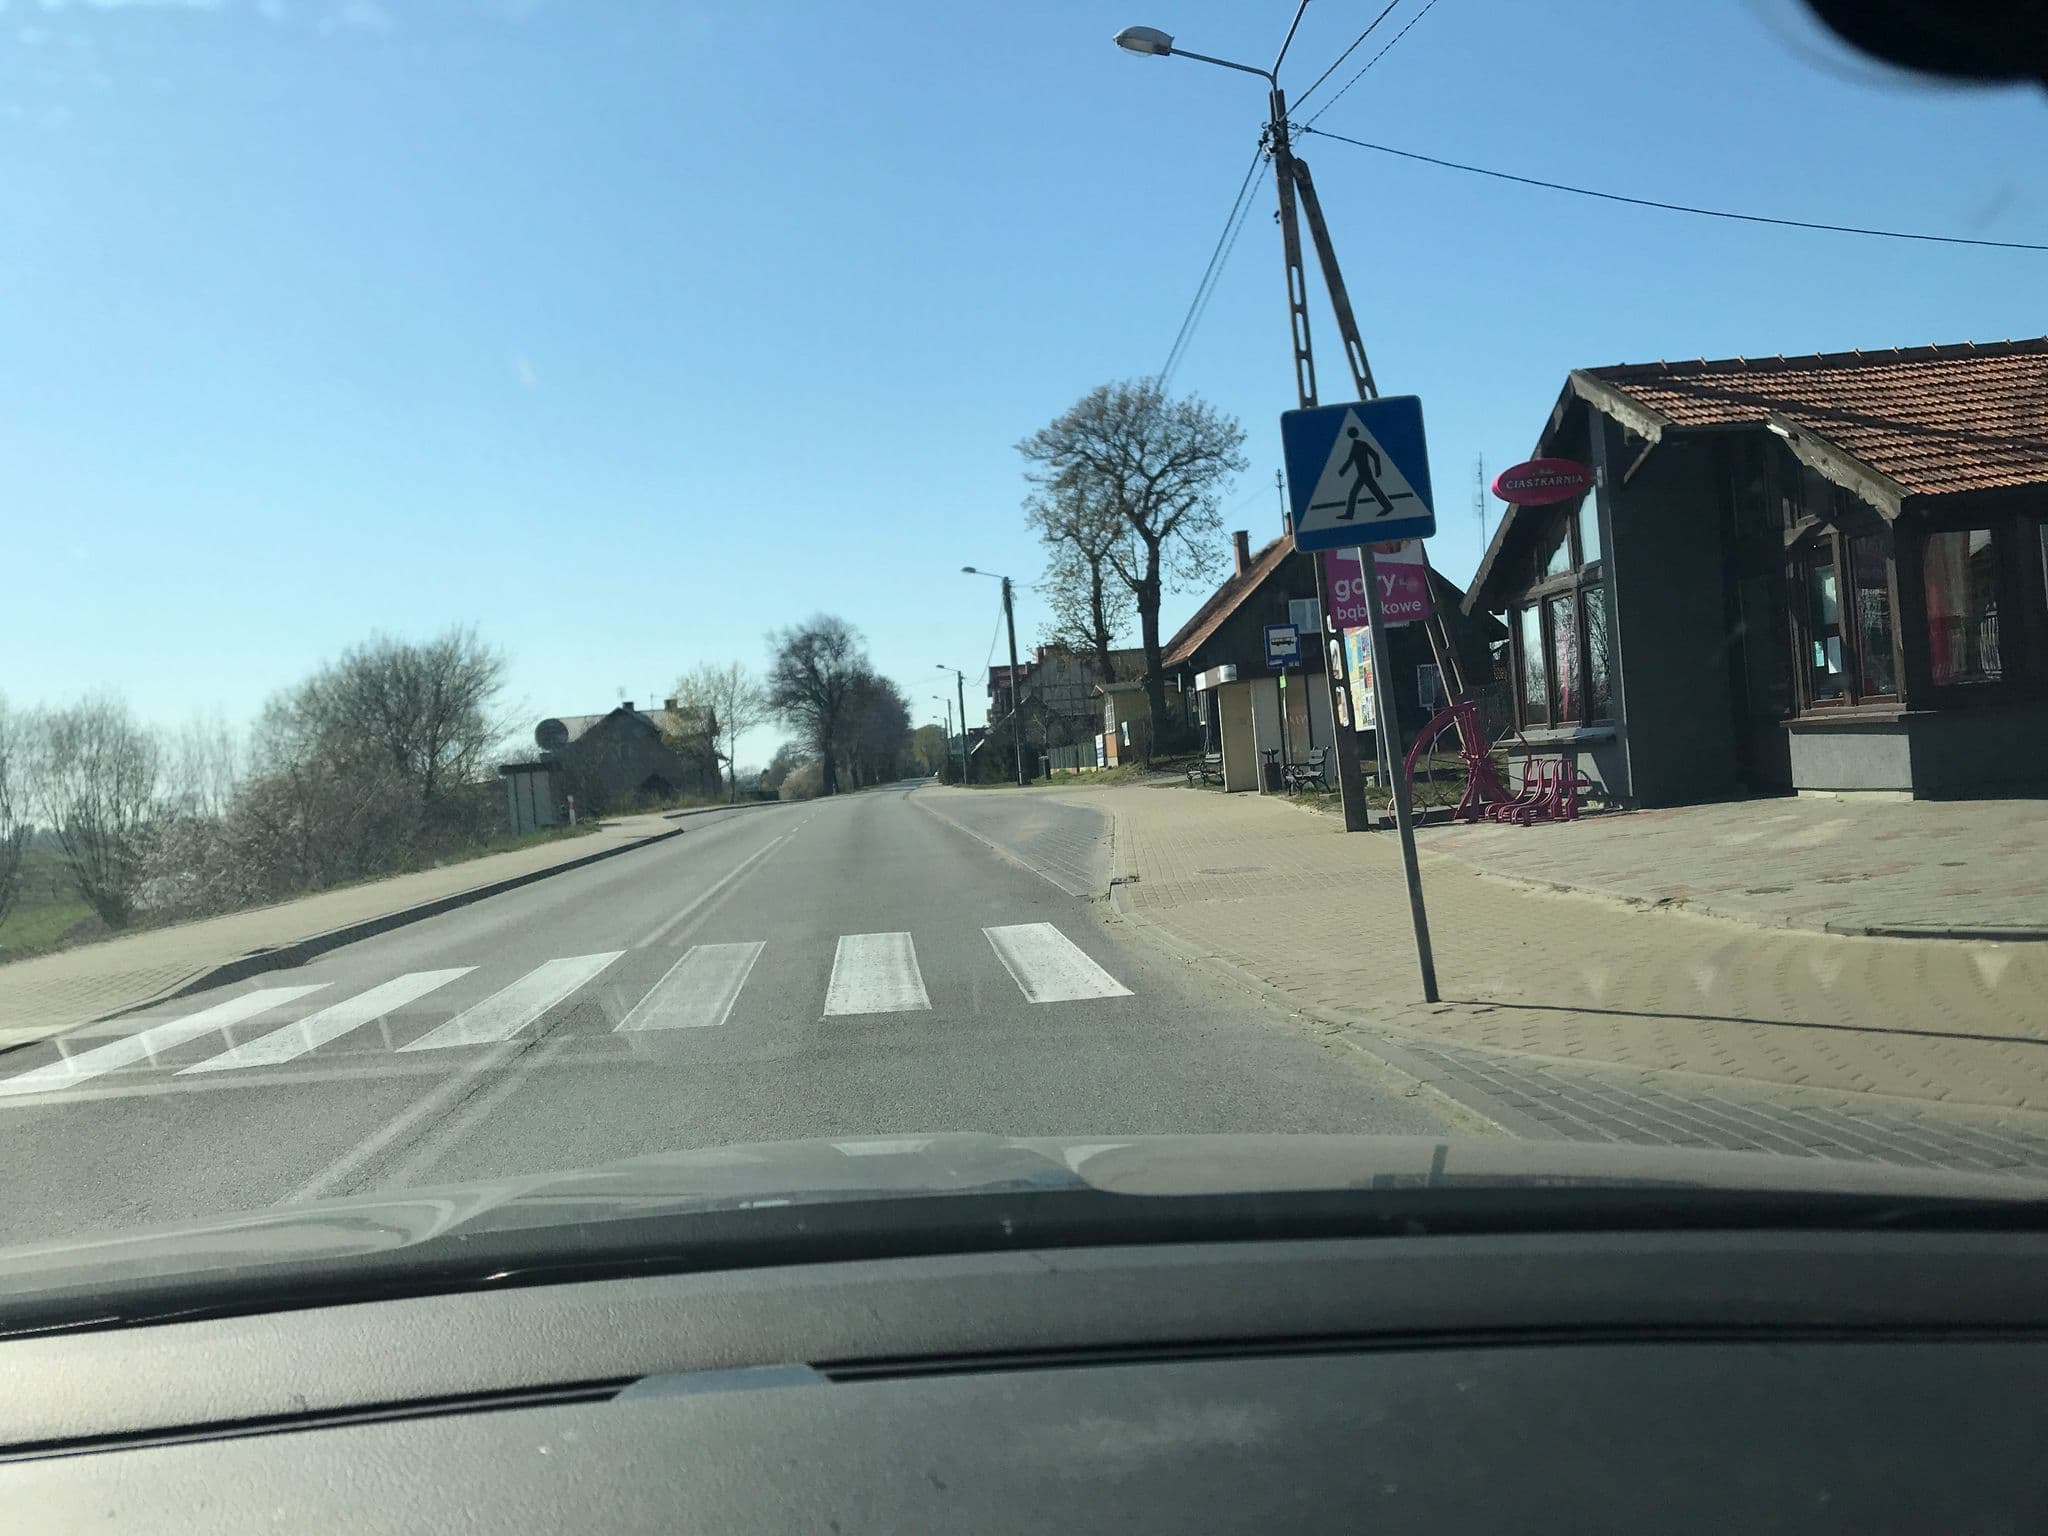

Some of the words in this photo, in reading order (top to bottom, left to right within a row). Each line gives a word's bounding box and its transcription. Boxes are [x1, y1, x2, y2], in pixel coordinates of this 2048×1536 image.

[1506, 474, 1584, 490] CIASTKARNIA
[1334, 573, 1397, 603] goy
[1336, 599, 1422, 622] bąbkowe
